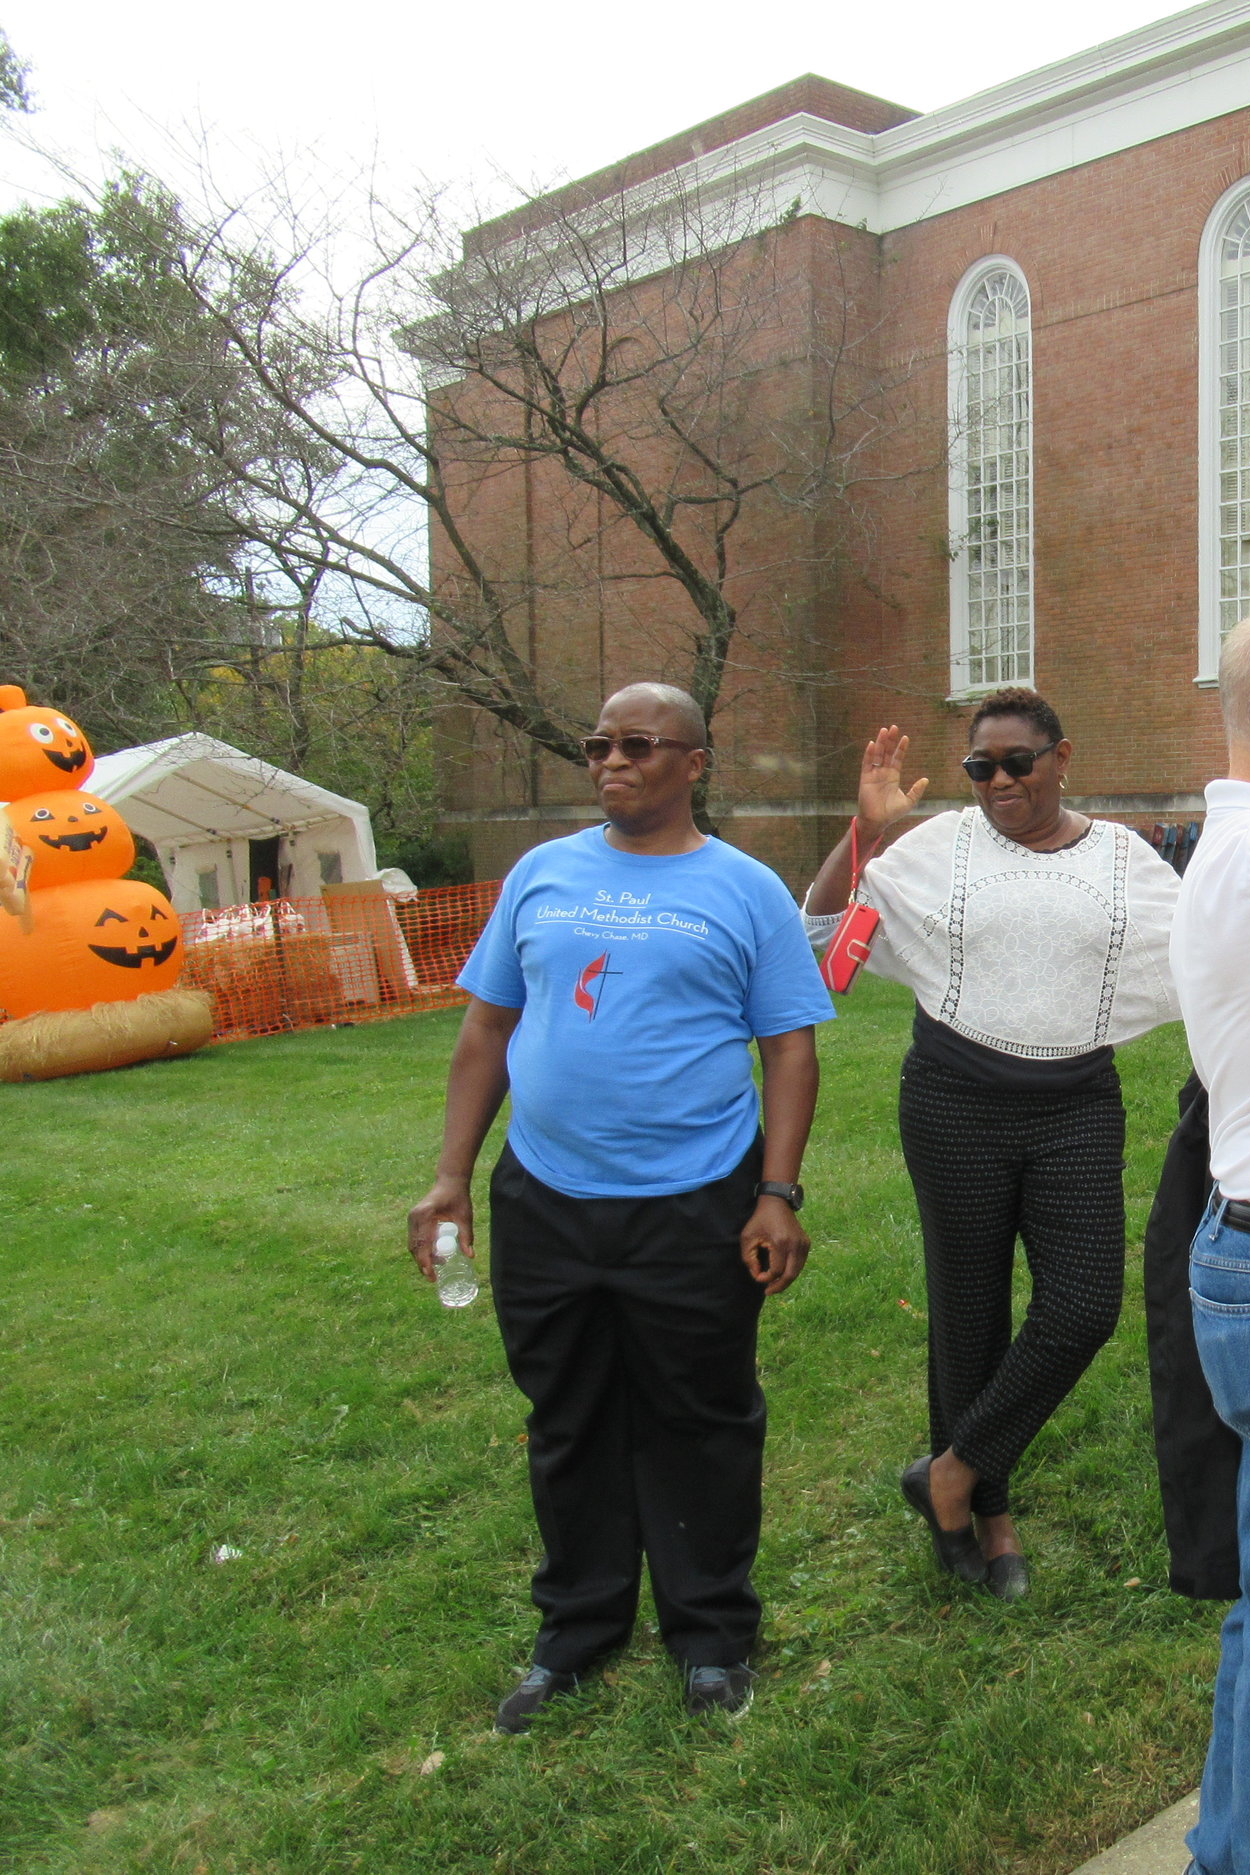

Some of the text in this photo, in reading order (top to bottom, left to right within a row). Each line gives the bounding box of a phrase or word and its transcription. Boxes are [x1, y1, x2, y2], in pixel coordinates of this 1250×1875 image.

[594, 889, 652, 905] St. Paul
[537, 905, 709, 935] United Methodist Church
[574, 926, 600, 939] Chevy
[631, 932, 649, 941] MD
